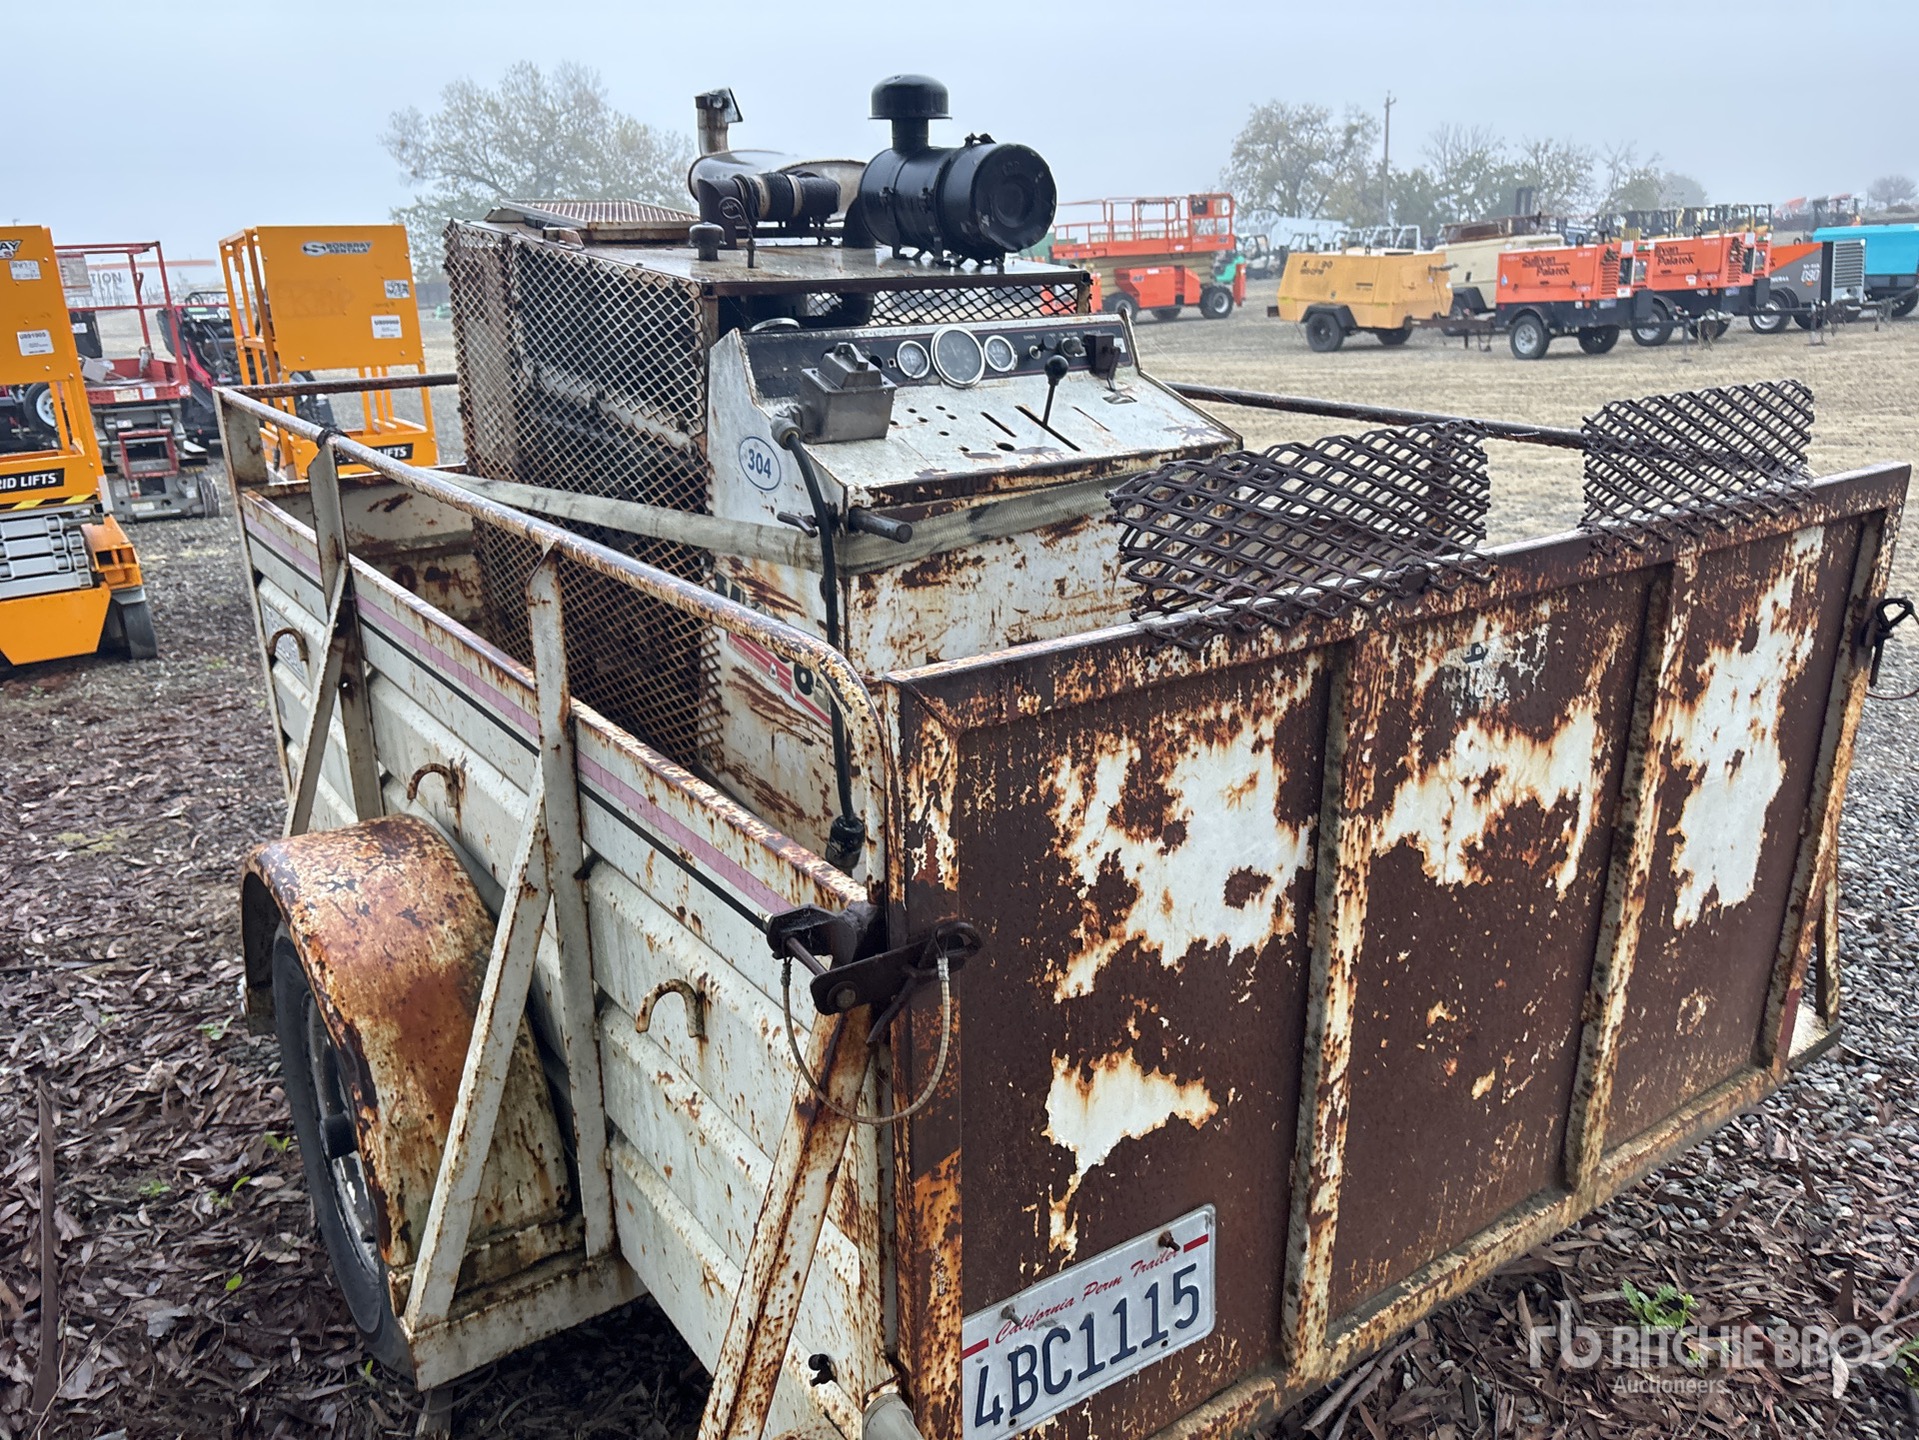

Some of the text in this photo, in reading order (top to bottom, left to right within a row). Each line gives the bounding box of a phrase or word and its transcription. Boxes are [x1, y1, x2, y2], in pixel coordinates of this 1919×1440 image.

[20, 472, 57, 488] LIFTS
[748, 448, 772, 479] 304
[994, 1250, 1178, 1344] California Perm Trailer
[974, 1262, 1200, 1429] 4BC1115
